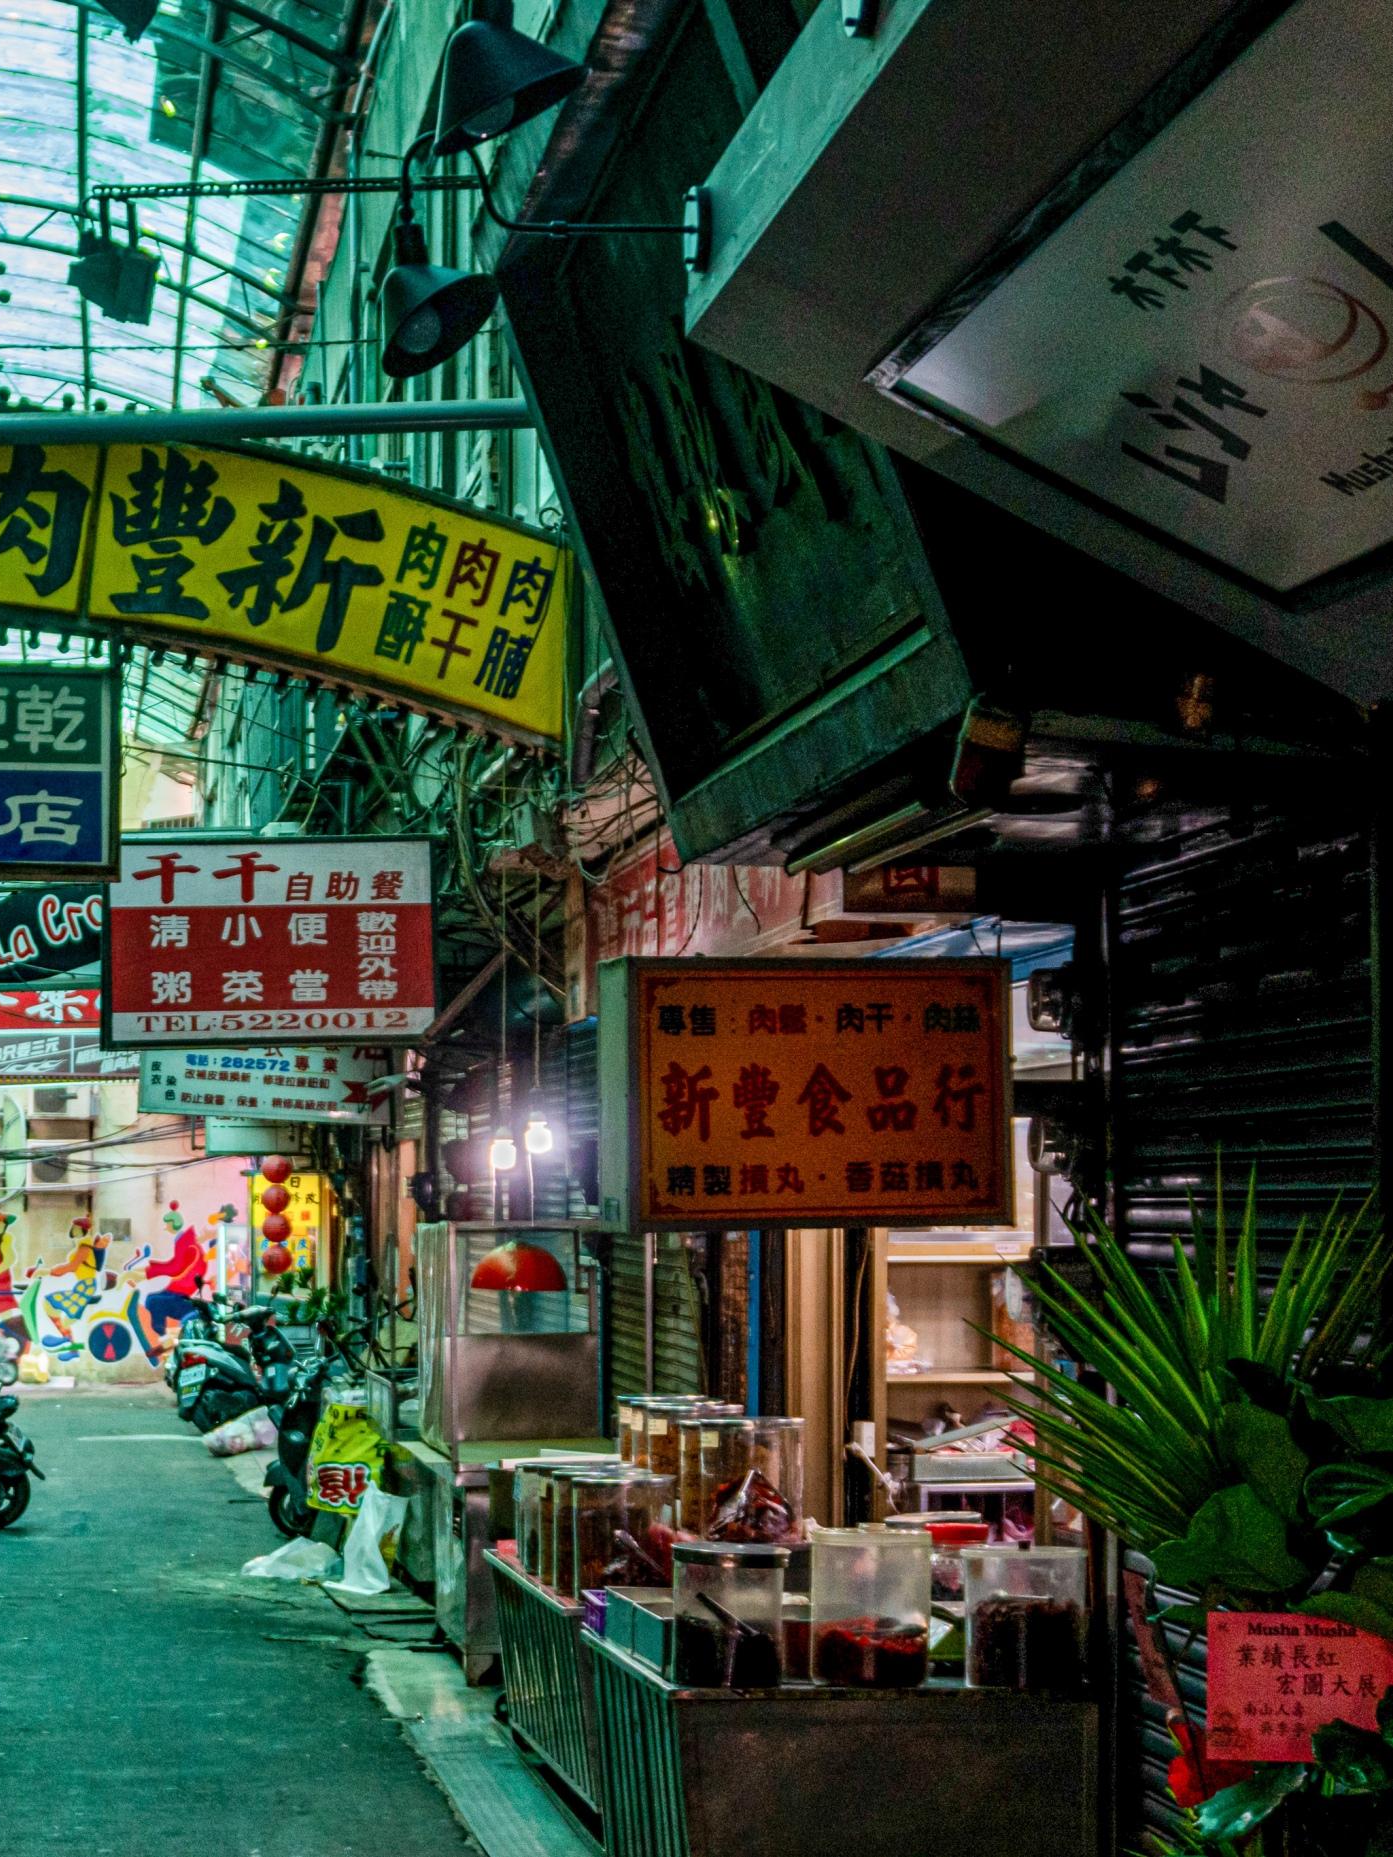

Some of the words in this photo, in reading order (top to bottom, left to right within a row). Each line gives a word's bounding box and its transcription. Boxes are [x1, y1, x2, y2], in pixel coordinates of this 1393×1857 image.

[285, 870, 405, 902] 自助餐
[221, 913, 264, 1003] 小菜
[287, 912, 330, 1002] 便當
[356, 910, 399, 1001] 歡迎外帶
[658, 1061, 984, 1142] 新豐食品行
[1236, 1643, 1340, 1670] 業績長紅
[1247, 1623, 1300, 1637] Musha
[1304, 1623, 1358, 1638] Musha
[1276, 1673, 1378, 1699] 宏圖大展
